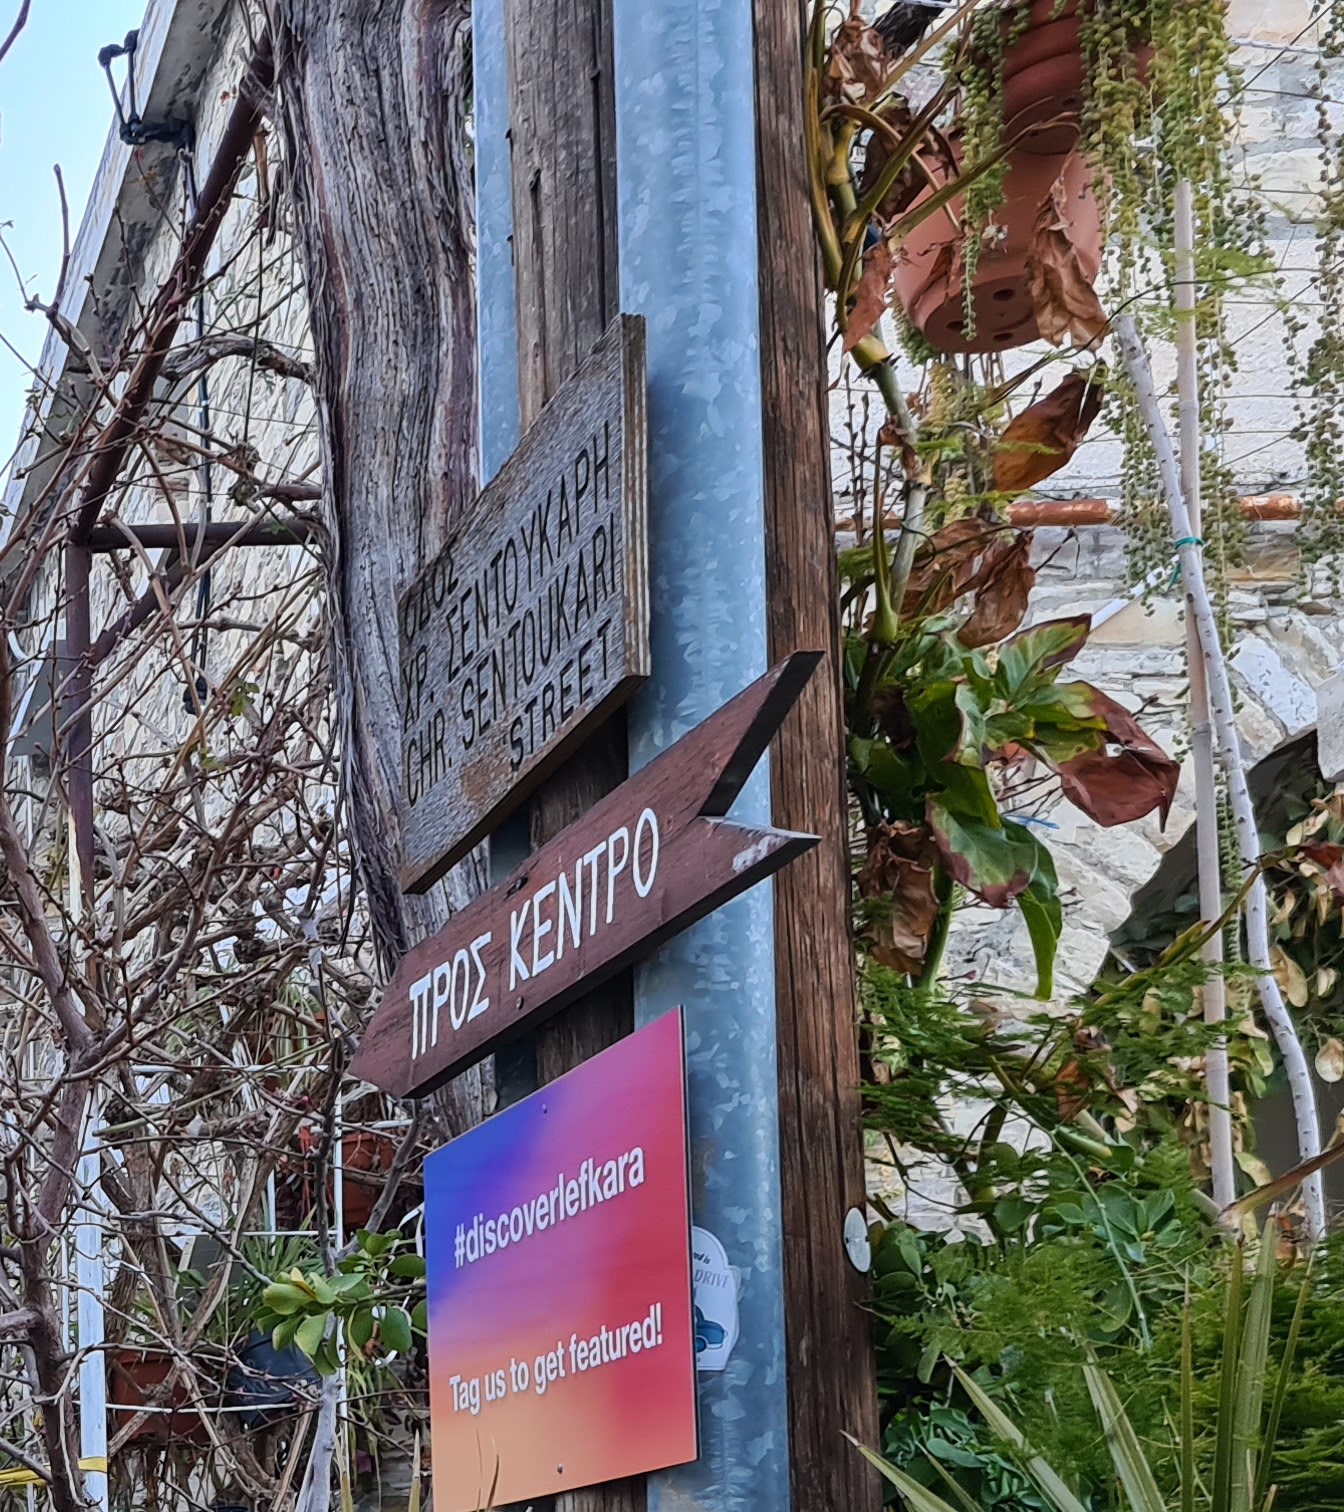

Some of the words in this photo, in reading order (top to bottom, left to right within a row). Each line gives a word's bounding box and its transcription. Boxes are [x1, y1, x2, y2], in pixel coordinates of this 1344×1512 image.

[446, 419, 610, 684] ΣΕΝΤΟΥΚΑΡΗ
[407, 707, 452, 808] CHR.
[461, 511, 616, 751] SENTOUKARI
[510, 617, 612, 772] STREET
[409, 931, 493, 1060] ΠΡΟΣ
[509, 807, 660, 992] ΚΕΝΤΡΟ
[454, 1146, 645, 1268] #discoverlefkara
[449, 1374, 481, 1415] Tag
[484, 1368, 506, 1401] us
[510, 1357, 529, 1393] to
[534, 1340, 565, 1395] get
[569, 1302, 663, 1374] featured!
